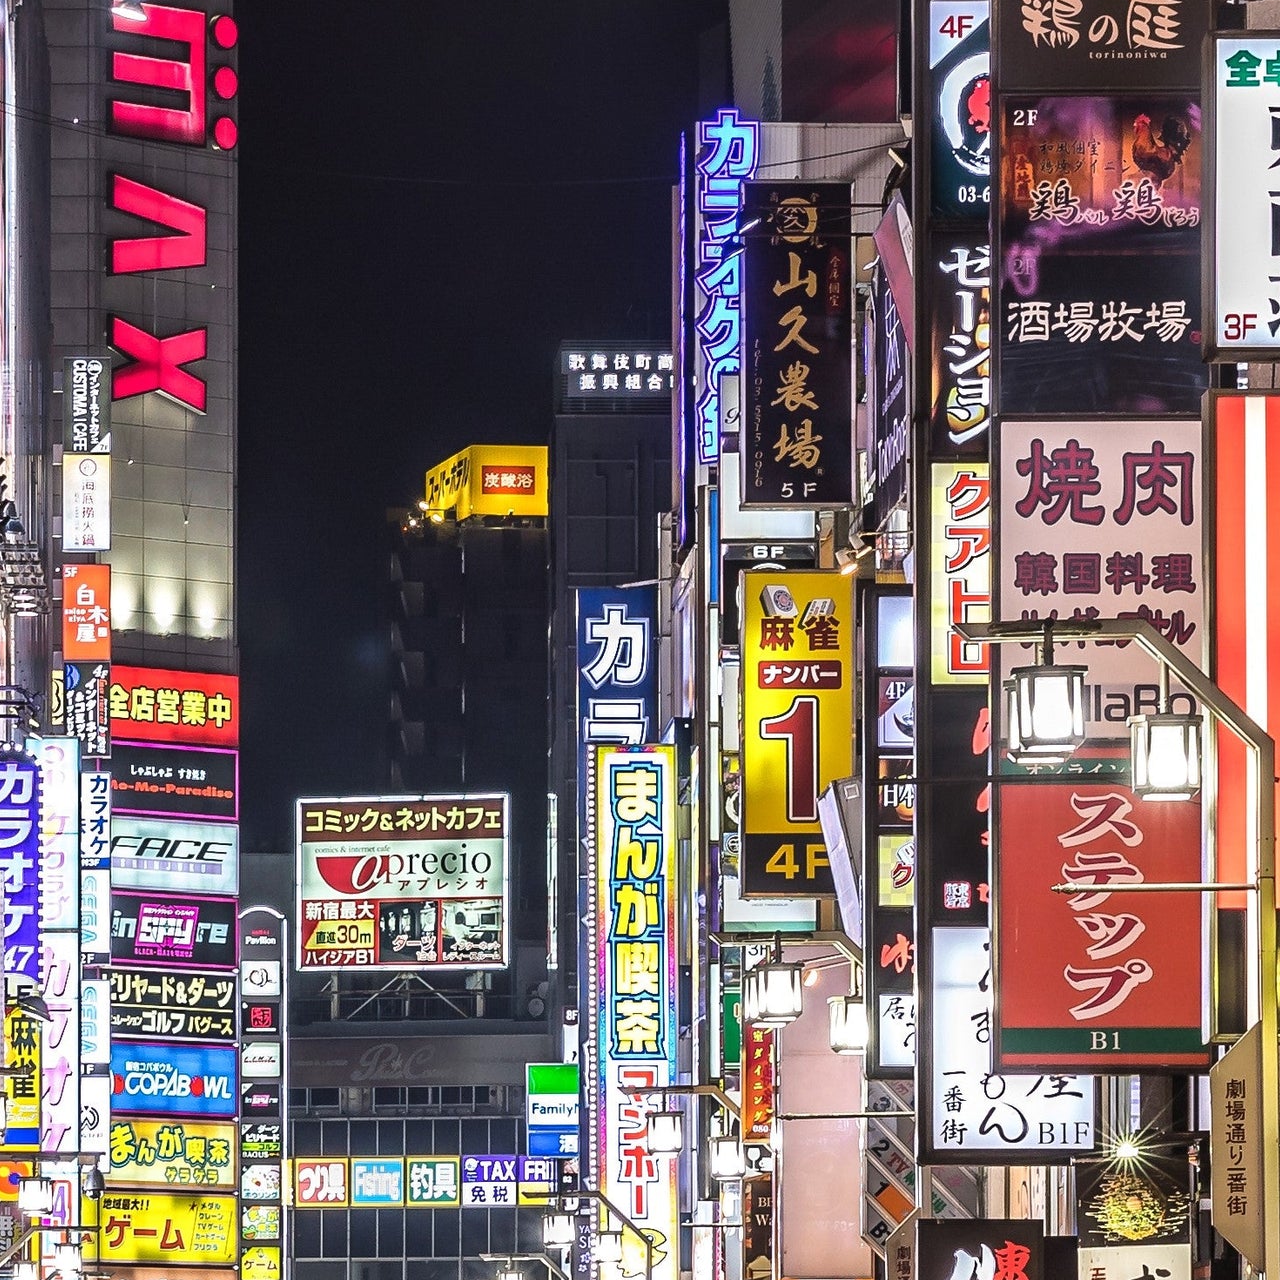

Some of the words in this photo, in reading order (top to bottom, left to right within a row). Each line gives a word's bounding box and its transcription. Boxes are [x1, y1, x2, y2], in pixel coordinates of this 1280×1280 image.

[939, 15, 975, 38] 4F
[1089, 50, 1168, 59] torinoniwa
[1013, 109, 1038, 126] 2F
[1008, 300, 1192, 343] 酒場牧場
[1224, 313, 1258, 339] 3F
[771, 251, 821, 470] 山久農場
[428, 456, 470, 502] スーパーホテル
[484, 471, 533, 489] 炭酸浴
[780, 482, 817, 498] 5F
[1015, 438, 1195, 526] 焼肉
[752, 545, 784, 559] 6F
[64, 567, 78, 578] 5F
[946, 472, 990, 673] クアトロ
[1014, 551, 1196, 596] 韓国料理
[760, 615, 840, 652] 麻雀
[762, 664, 838, 685] ナンバー
[110, 683, 232, 728] 全店営業中
[759, 695, 820, 824] 1
[90, 775, 108, 855] カラオケ
[305, 806, 501, 834] コミック&ネットカフェ
[112, 834, 232, 862] FACE
[765, 844, 831, 880] 4F
[398, 878, 488, 891] アプレシオ
[83, 876, 98, 944] SEGA
[305, 901, 374, 919] 新宿最大
[615, 769, 659, 1054] まんが喫茶
[1057, 791, 1153, 1021] ステップ
[245, 935, 276, 946] Pavilion
[392, 935, 437, 952] ダーツ
[306, 949, 374, 965] ハイジアB1
[83, 987, 98, 1056] SEGA
[142, 1012, 185, 1034] ゴルフ
[188, 1016, 233, 1035] バグース
[1089, 1031, 1120, 1050] B1
[10, 1015, 38, 1099] 麻雀
[939, 1070, 968, 1145] 一番街
[110, 1122, 231, 1166] まんが喫茶
[1038, 1121, 1089, 1145] B1F
[1225, 1079, 1247, 1217] 劇場通り一番街
[410, 1165, 457, 1202] 釣具
[481, 1160, 516, 1181] TAX
[470, 1186, 509, 1202] 免税
[105, 1215, 186, 1251] ゲーム
[244, 1260, 278, 1271] ゲーム
